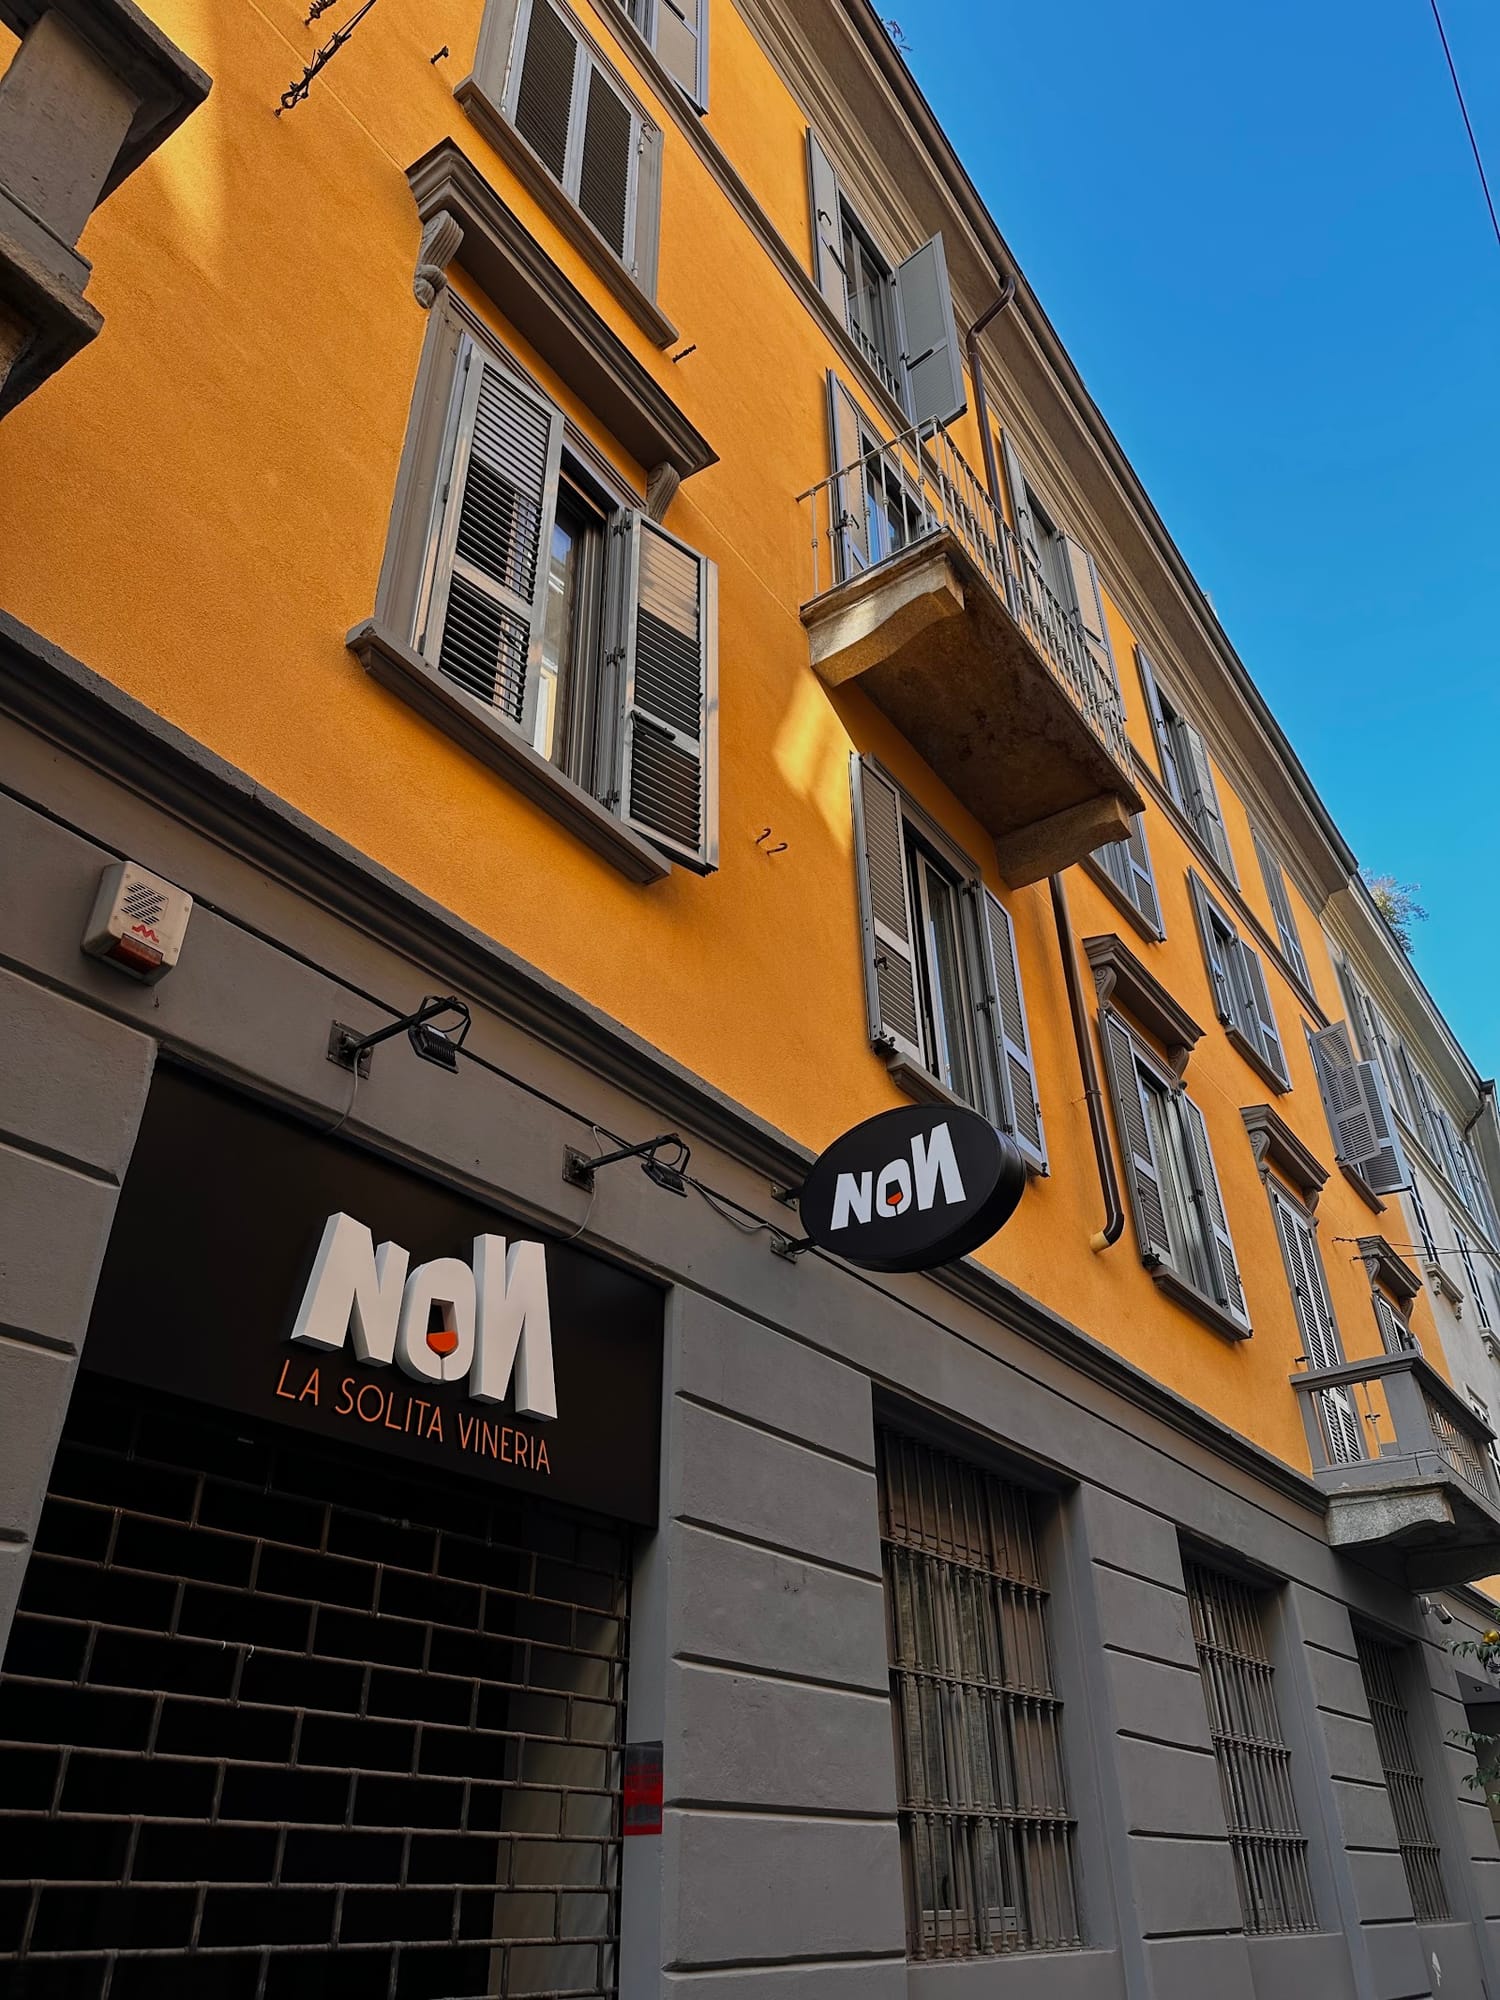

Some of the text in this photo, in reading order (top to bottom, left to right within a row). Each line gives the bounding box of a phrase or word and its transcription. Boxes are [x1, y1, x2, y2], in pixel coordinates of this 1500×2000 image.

[276, 1359, 550, 1474] LA SOLITA VINERIA
